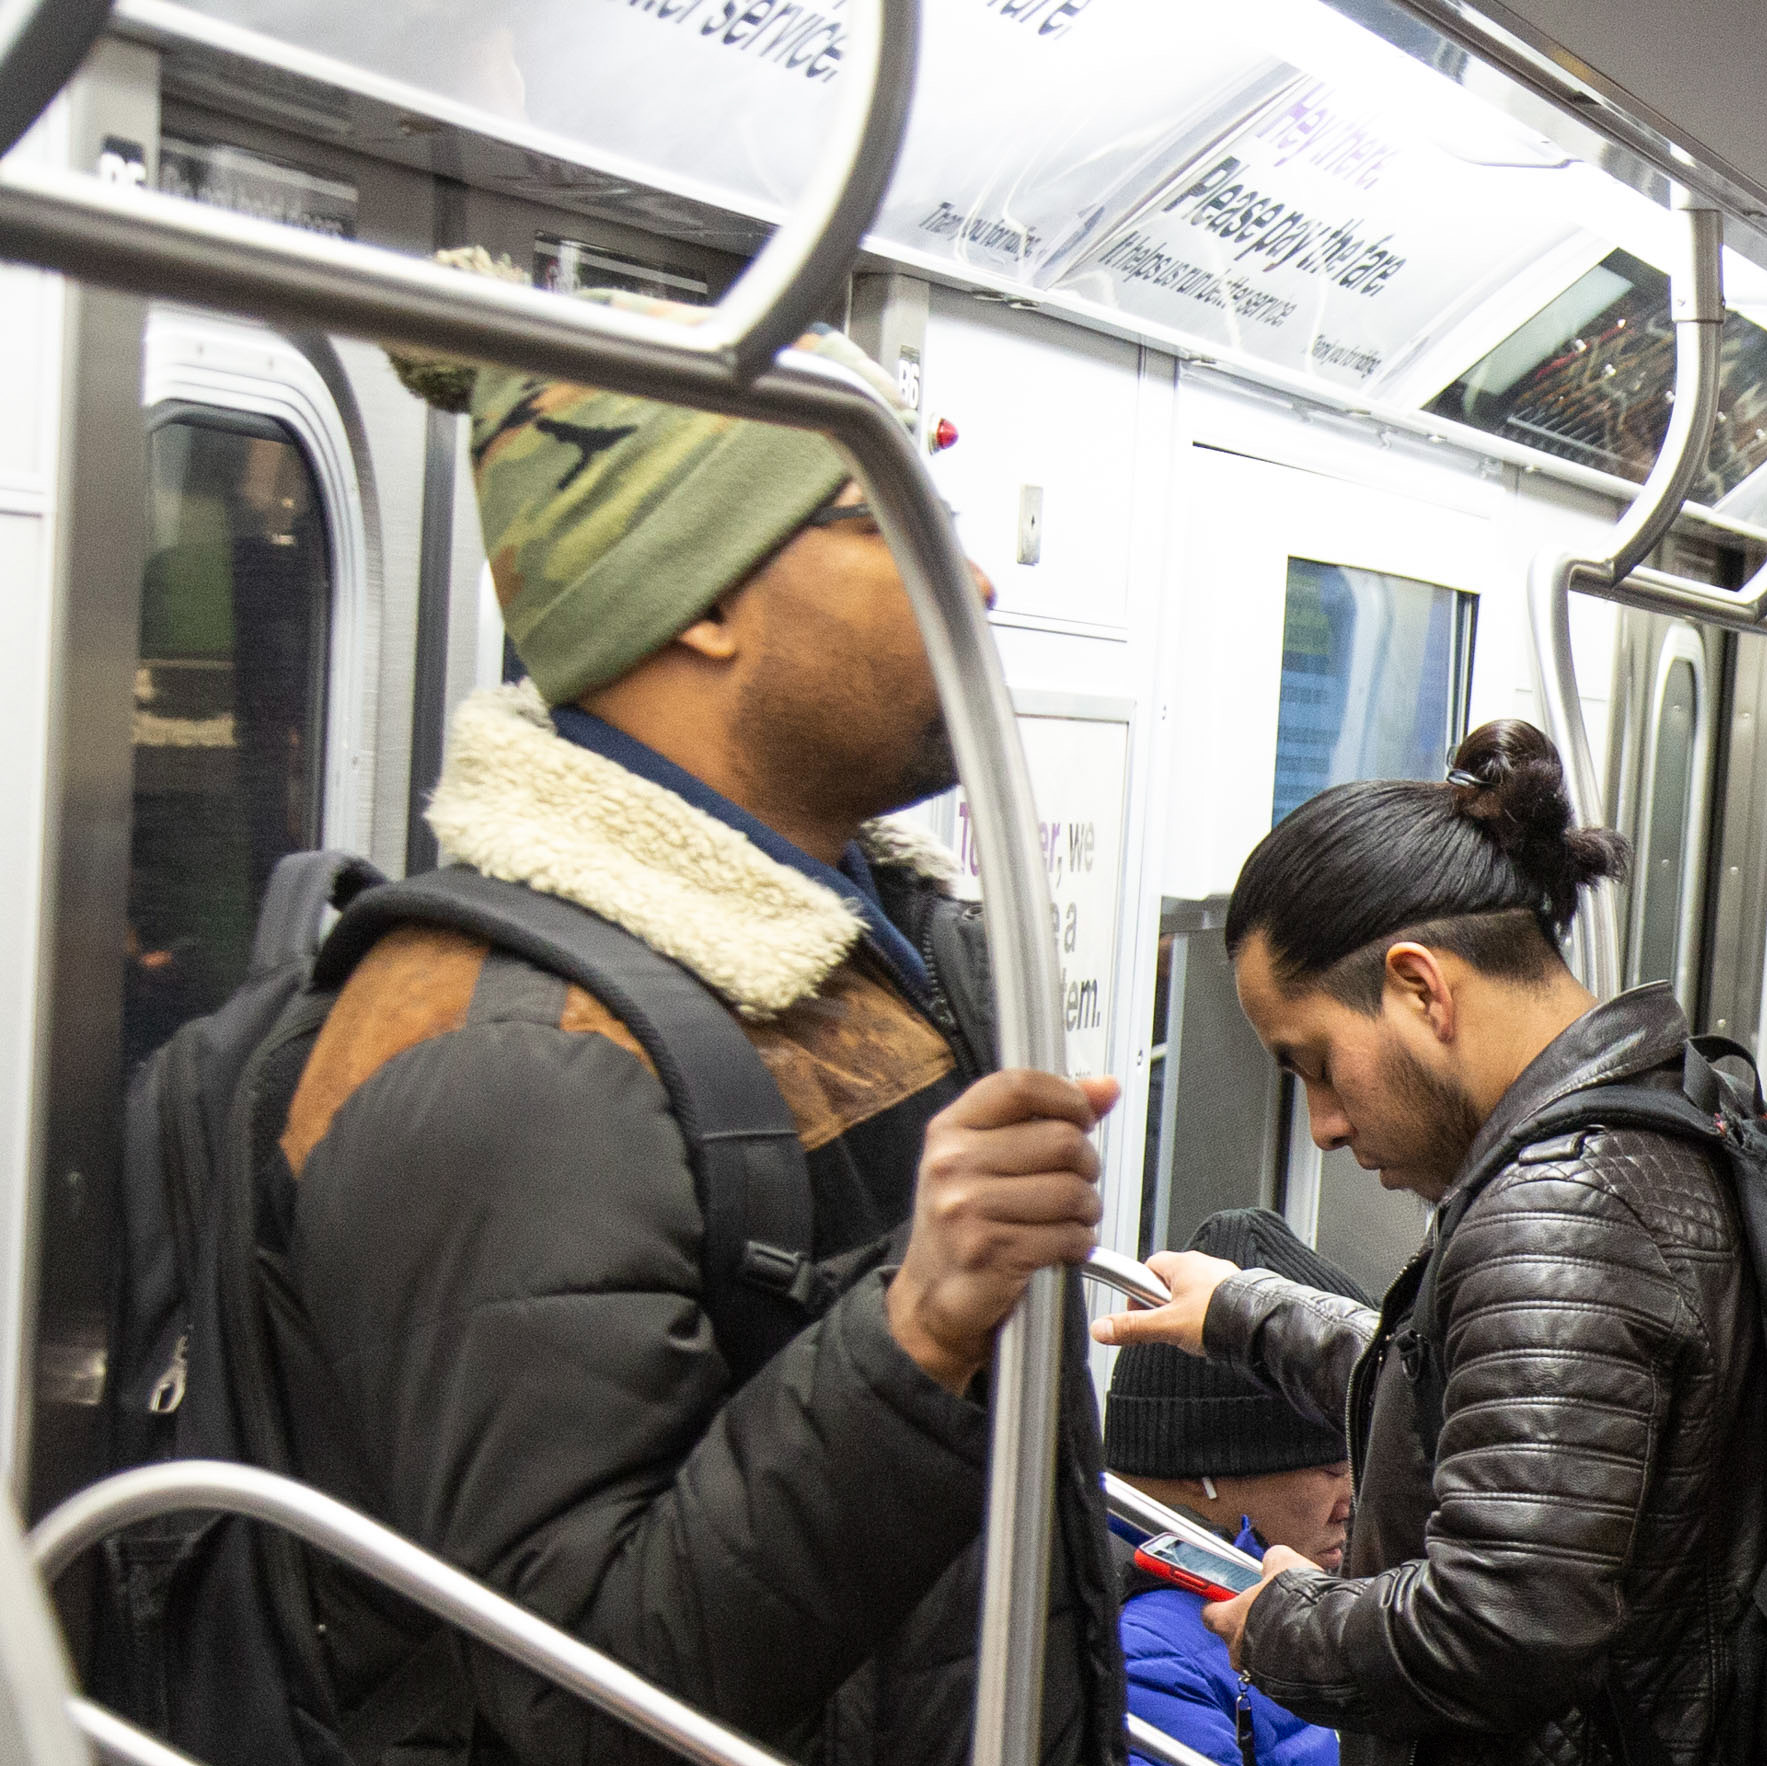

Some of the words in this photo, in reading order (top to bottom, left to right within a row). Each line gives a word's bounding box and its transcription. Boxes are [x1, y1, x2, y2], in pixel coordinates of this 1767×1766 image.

[1256, 82, 1336, 168] Hey
[1162, 155, 1285, 243] Please
[1234, 212, 1323, 273] pay
[1297, 218, 1365, 274] the
[1332, 233, 1407, 298] fare.
[1112, 236, 1171, 283] helps
[1236, 292, 1297, 328] service.
[1068, 820, 1095, 873] we
[1064, 902, 1077, 953] a
